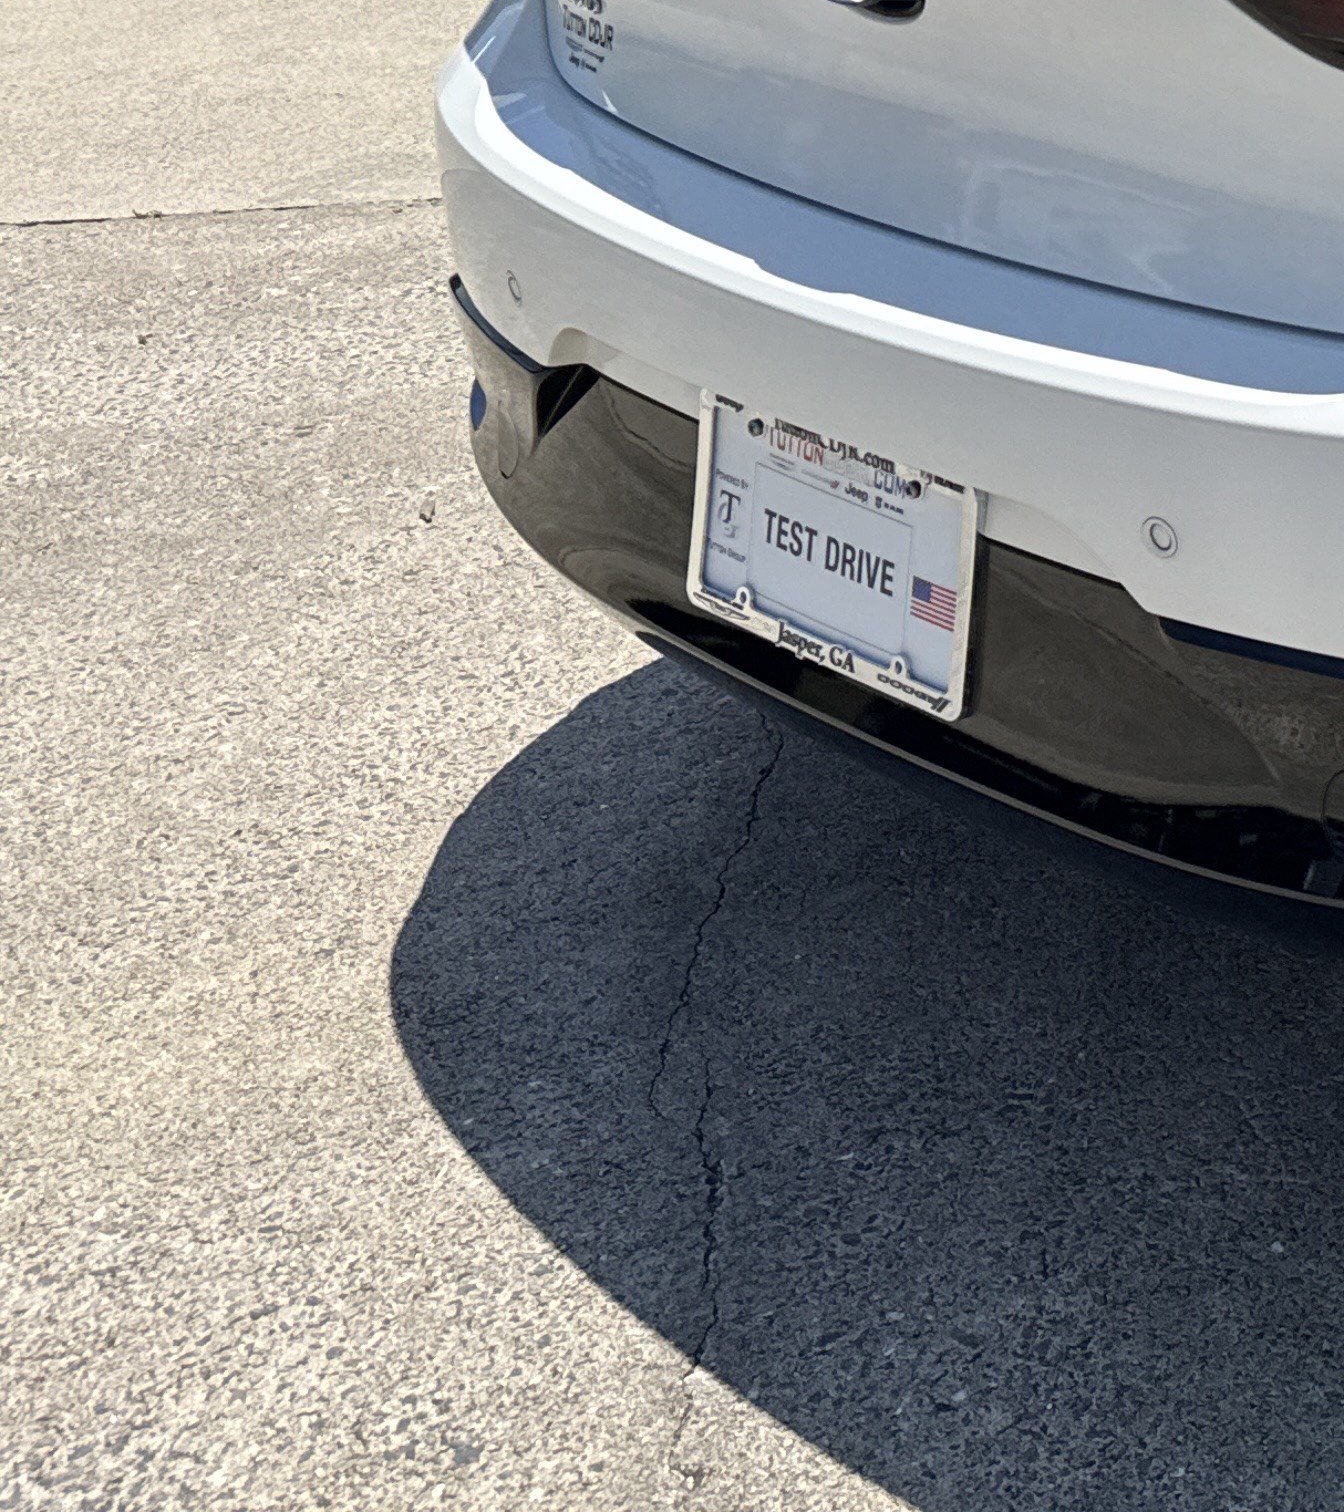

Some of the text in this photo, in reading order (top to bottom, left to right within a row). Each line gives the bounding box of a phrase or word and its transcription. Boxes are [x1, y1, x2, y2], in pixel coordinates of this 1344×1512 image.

[764, 508, 896, 598] TEST DRIVE
[829, 646, 856, 674] GA
